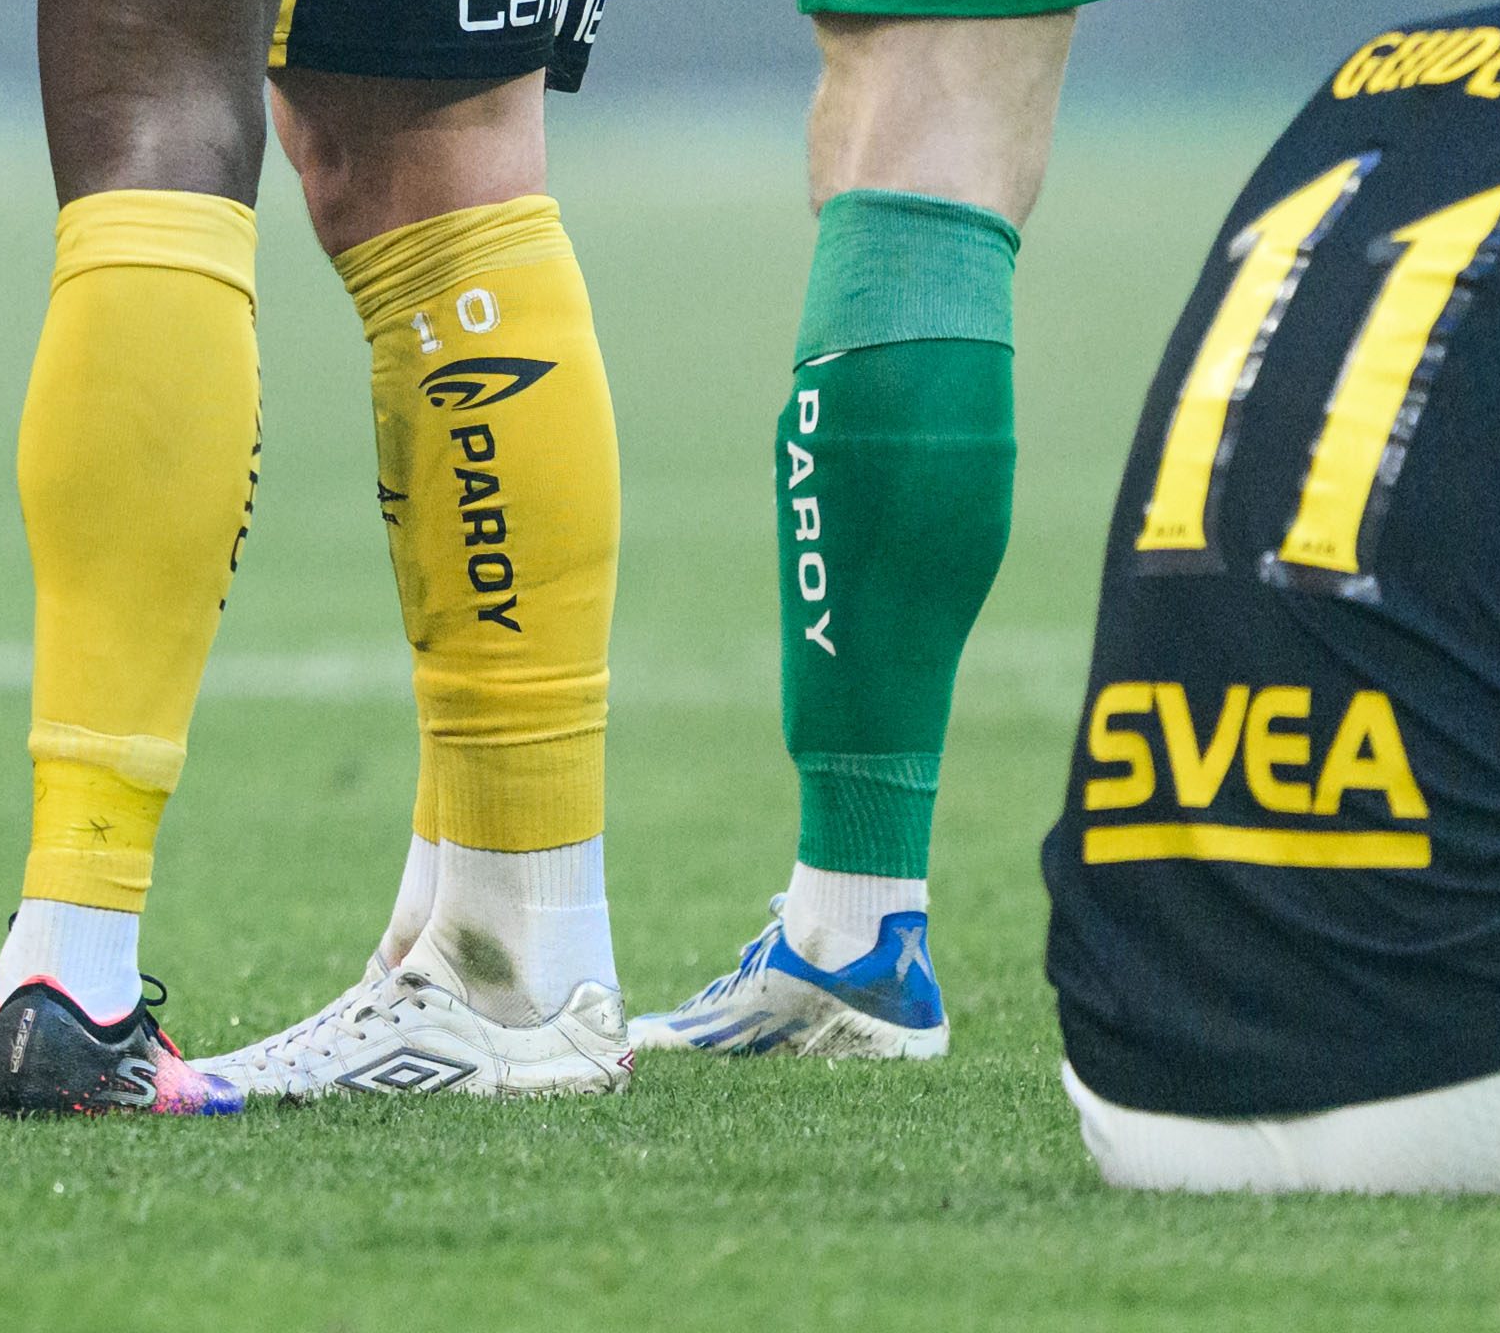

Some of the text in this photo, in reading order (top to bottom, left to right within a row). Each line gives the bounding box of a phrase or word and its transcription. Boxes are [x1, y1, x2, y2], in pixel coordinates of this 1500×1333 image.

[449, 422, 522, 634] PAROY
[787, 387, 837, 658] PAROY
[1082, 680, 1430, 820] SVEA
